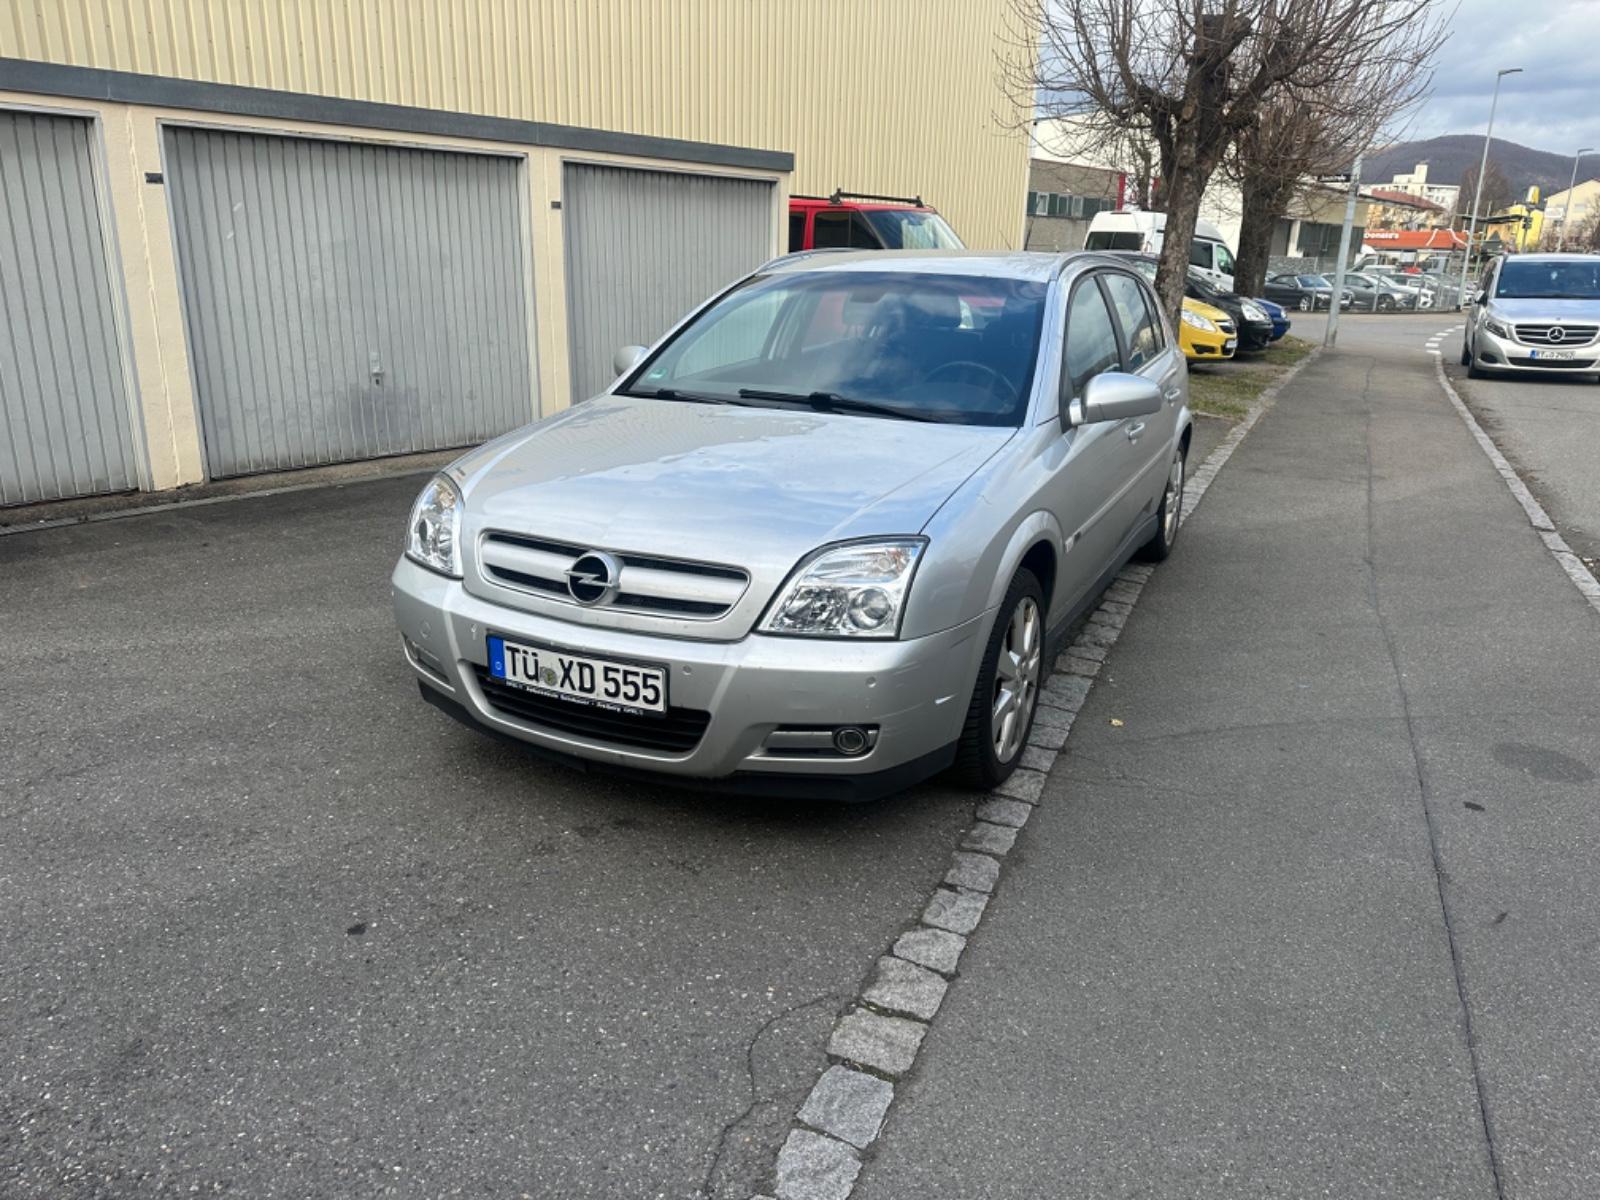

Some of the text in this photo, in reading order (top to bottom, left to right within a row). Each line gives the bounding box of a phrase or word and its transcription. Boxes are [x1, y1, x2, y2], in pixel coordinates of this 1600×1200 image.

[505, 646, 661, 705] TÜ XD 555
